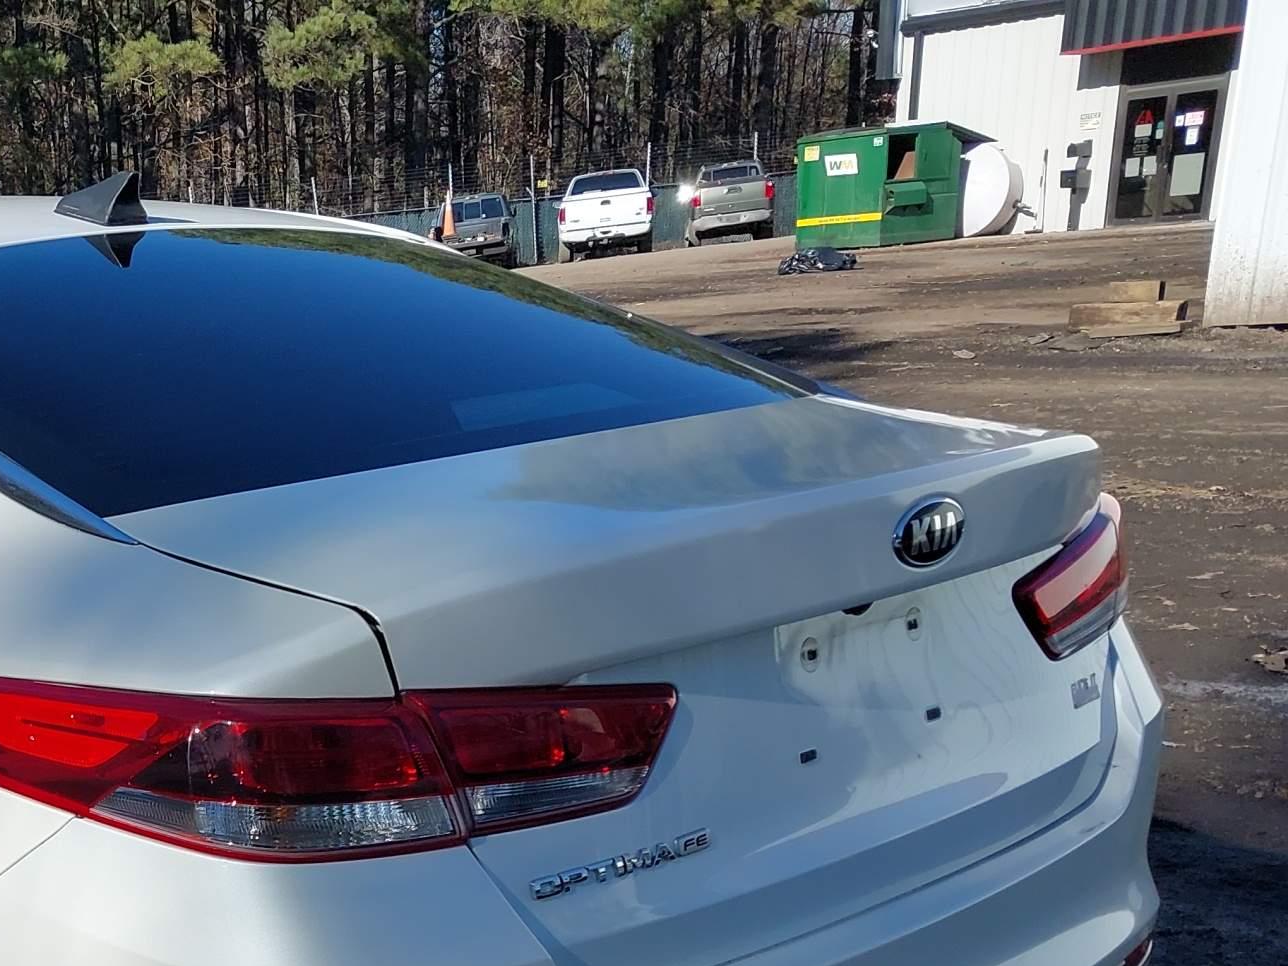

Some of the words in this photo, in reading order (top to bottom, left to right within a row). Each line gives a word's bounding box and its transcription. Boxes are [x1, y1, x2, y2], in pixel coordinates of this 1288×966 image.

[829, 159, 854, 171] WM
[909, 511, 957, 556] KIA
[529, 842, 678, 900] OPTIMA
